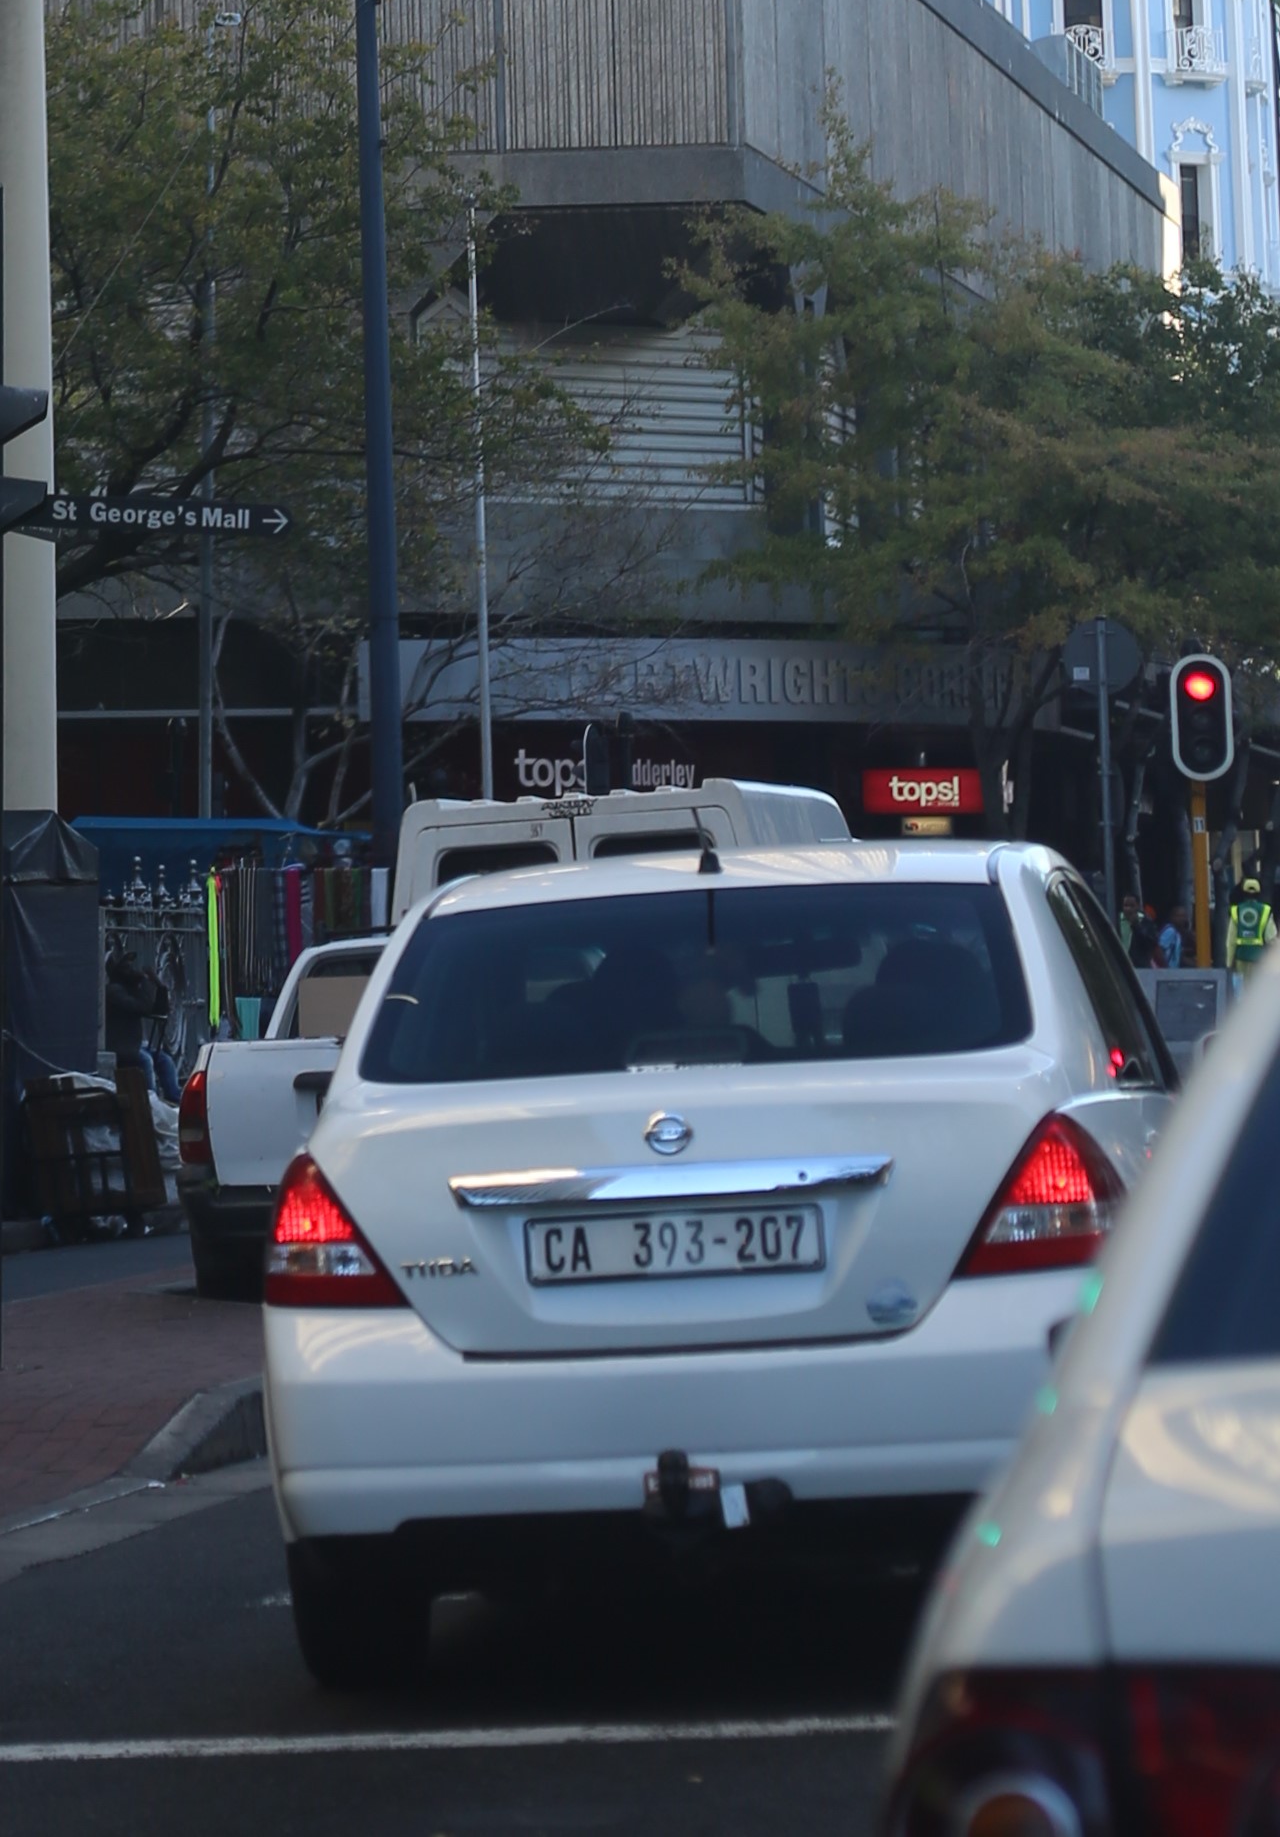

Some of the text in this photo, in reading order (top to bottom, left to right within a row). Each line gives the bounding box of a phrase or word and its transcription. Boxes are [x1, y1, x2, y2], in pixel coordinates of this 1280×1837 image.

[51, 499, 251, 530] St George's Mall
[888, 774, 961, 808] tops!
[544, 1214, 806, 1274] CA 393-207
[399, 1256, 480, 1279] TIIDA
